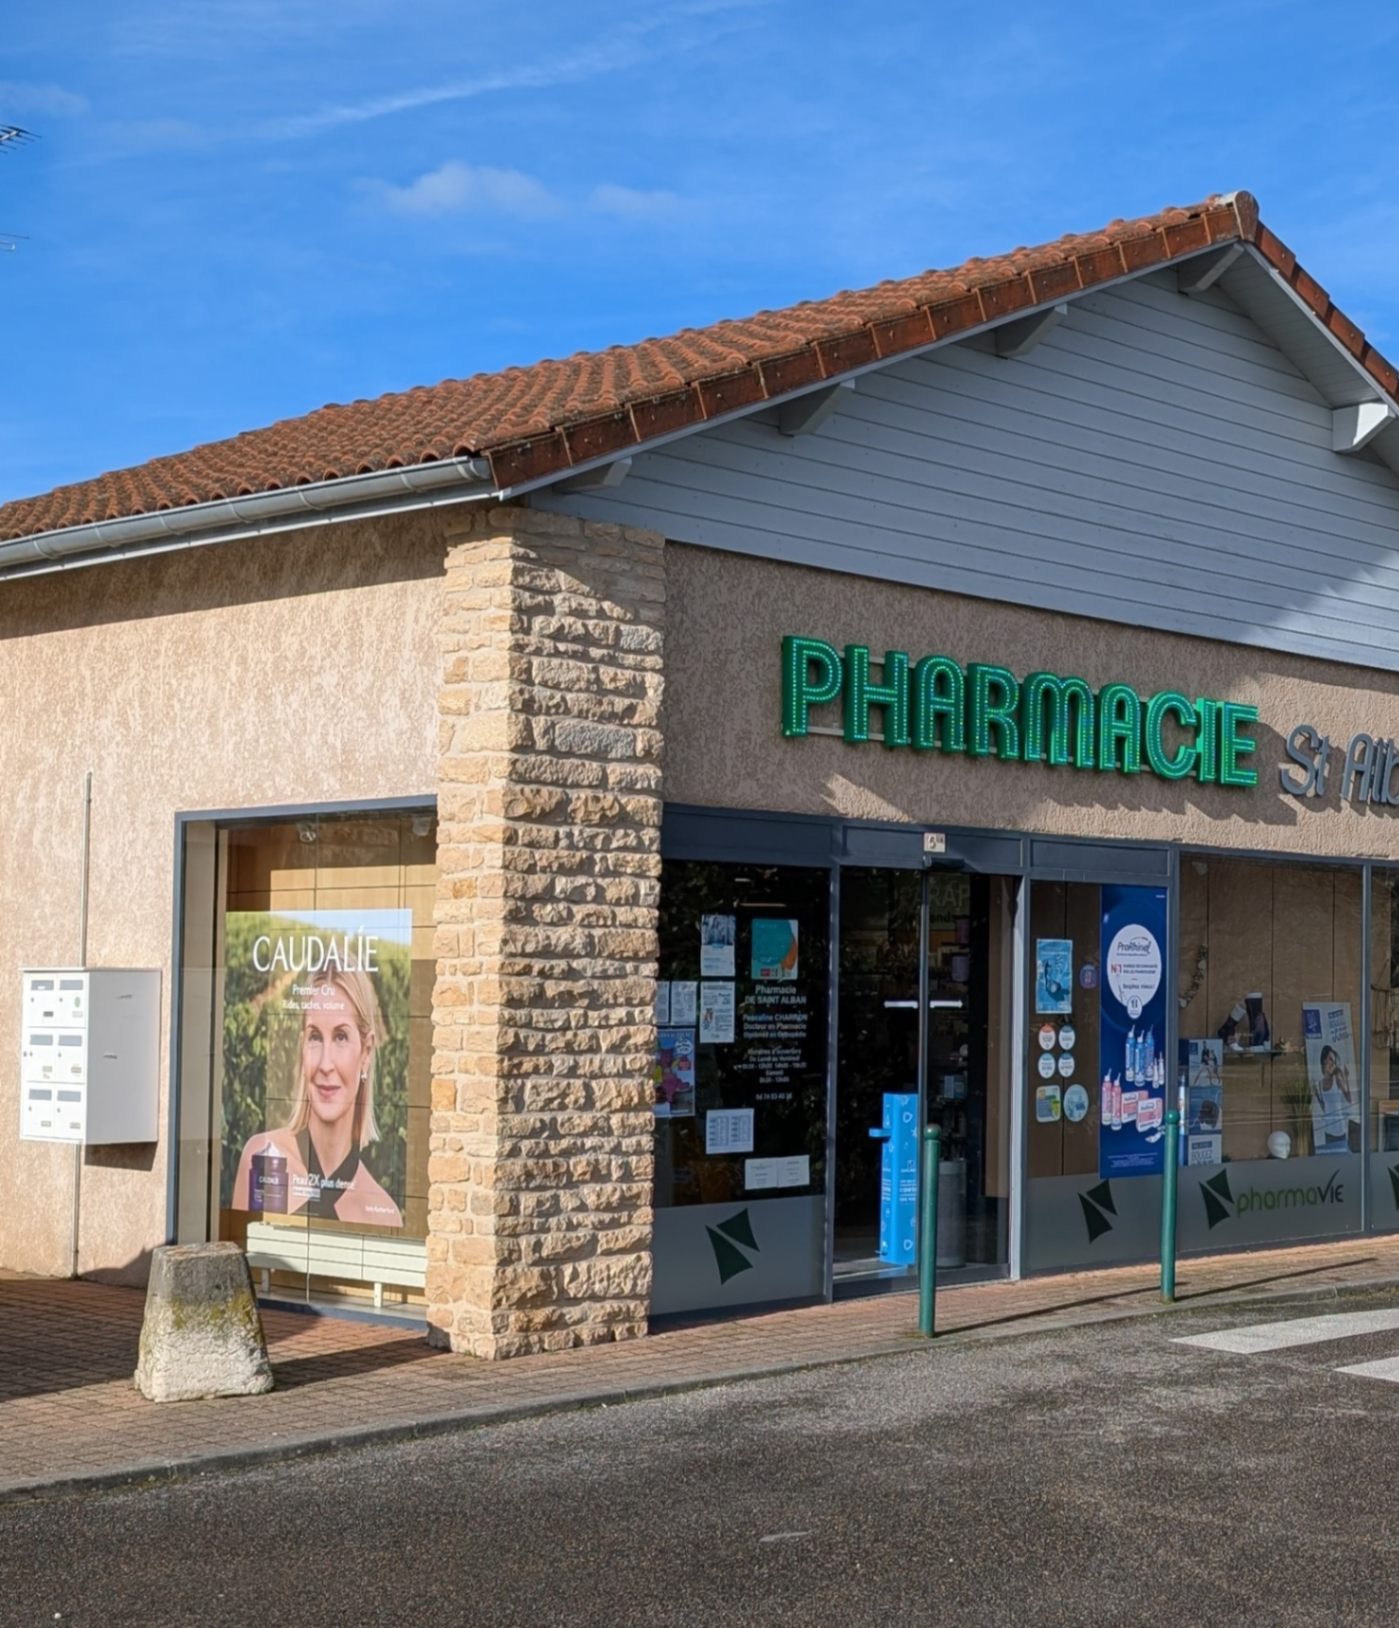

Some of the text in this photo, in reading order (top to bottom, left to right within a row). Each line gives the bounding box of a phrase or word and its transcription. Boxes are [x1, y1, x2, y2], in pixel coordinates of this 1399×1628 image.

[781, 635, 1259, 787] PHARMACIE
[1280, 724, 1330, 796] St
[755, 984, 797, 994] Pharmacie
[757, 995, 780, 1005] SAINT
[780, 995, 807, 1005] ALBAN
